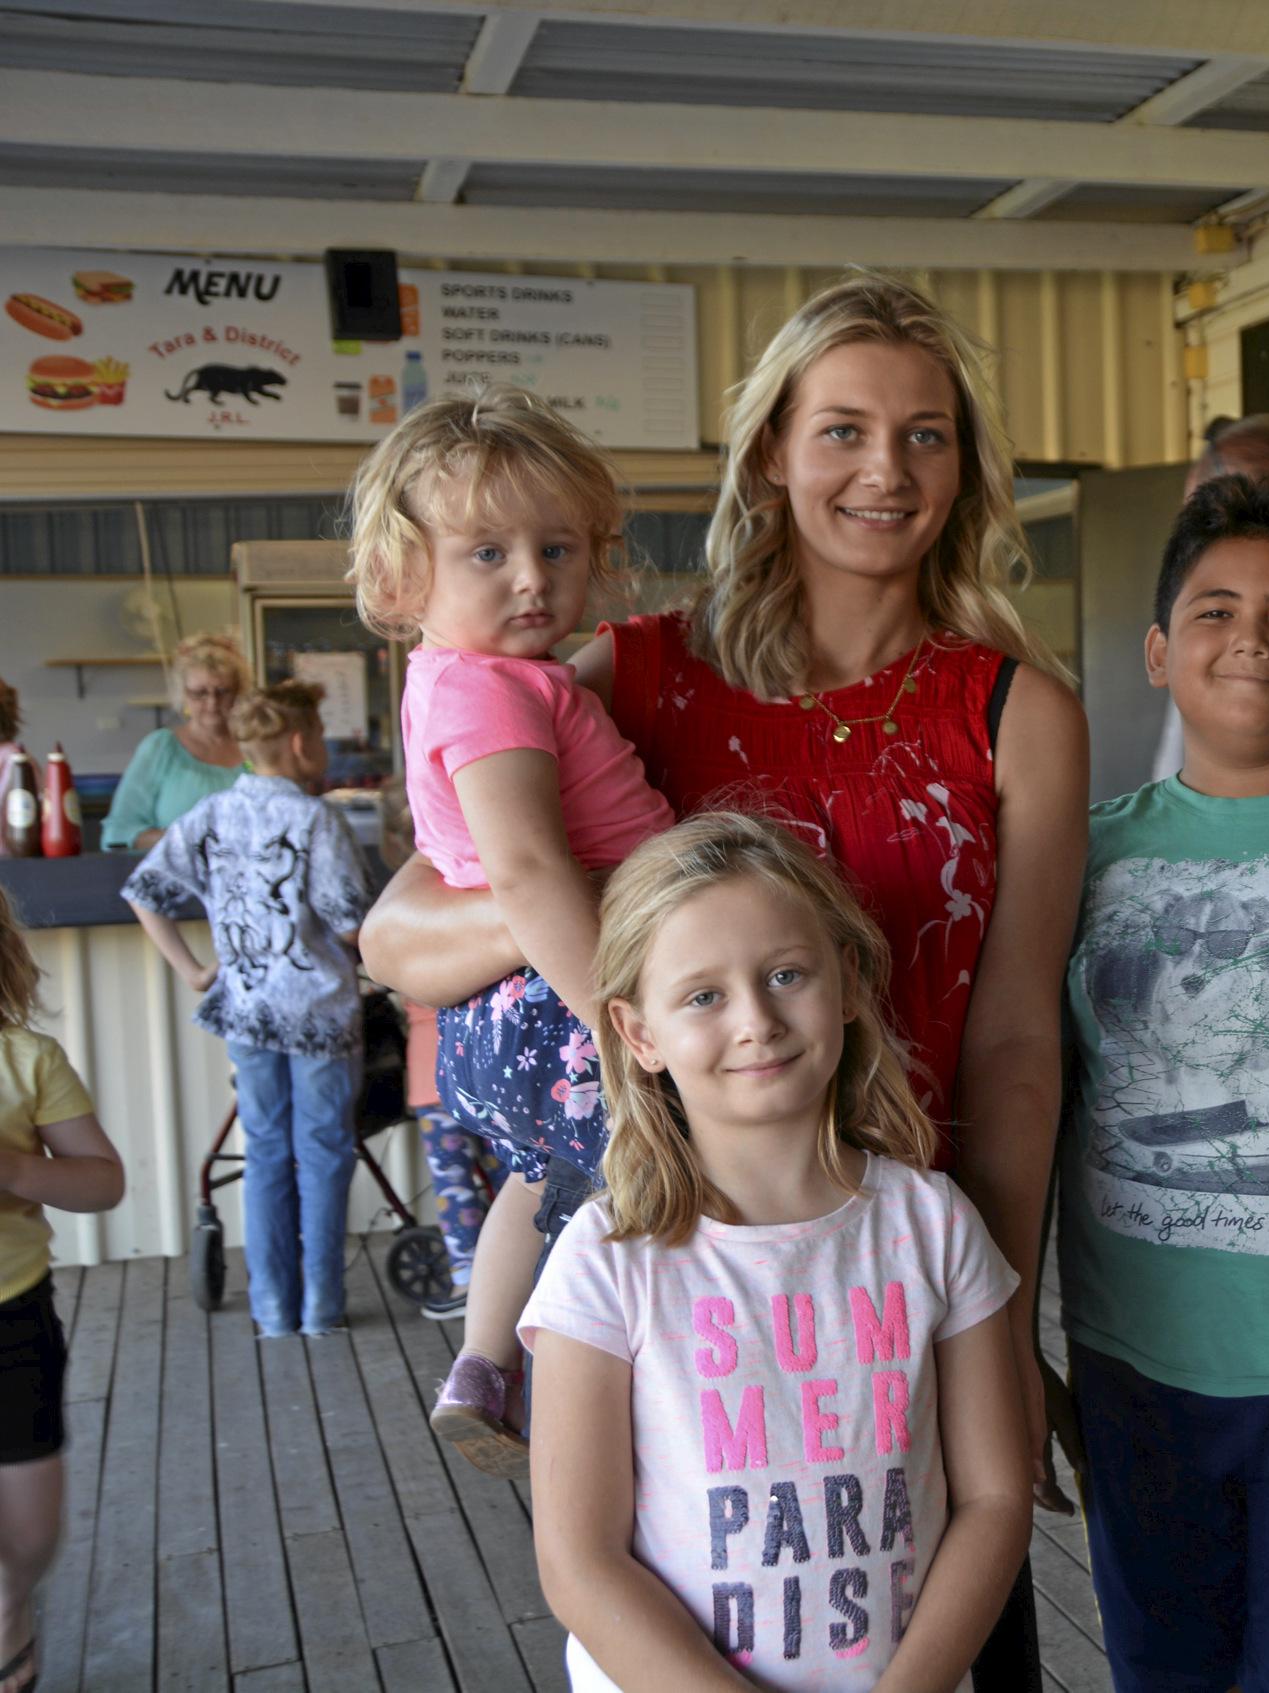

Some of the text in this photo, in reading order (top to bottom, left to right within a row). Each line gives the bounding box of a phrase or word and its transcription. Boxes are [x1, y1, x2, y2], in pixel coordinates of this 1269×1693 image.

[164, 267, 282, 306] MENU
[440, 283, 573, 303] SPORTS DRINKS
[441, 306, 500, 319] WATER
[441, 327, 485, 341] SOFT
[490, 329, 551, 344] DRINKS
[148, 325, 303, 367] Tara & District
[440, 349, 521, 364] POPPERS
[1127, 1203, 1153, 1226] the
[1157, 1205, 1208, 1242] good
[1211, 1210, 1264, 1231] times
